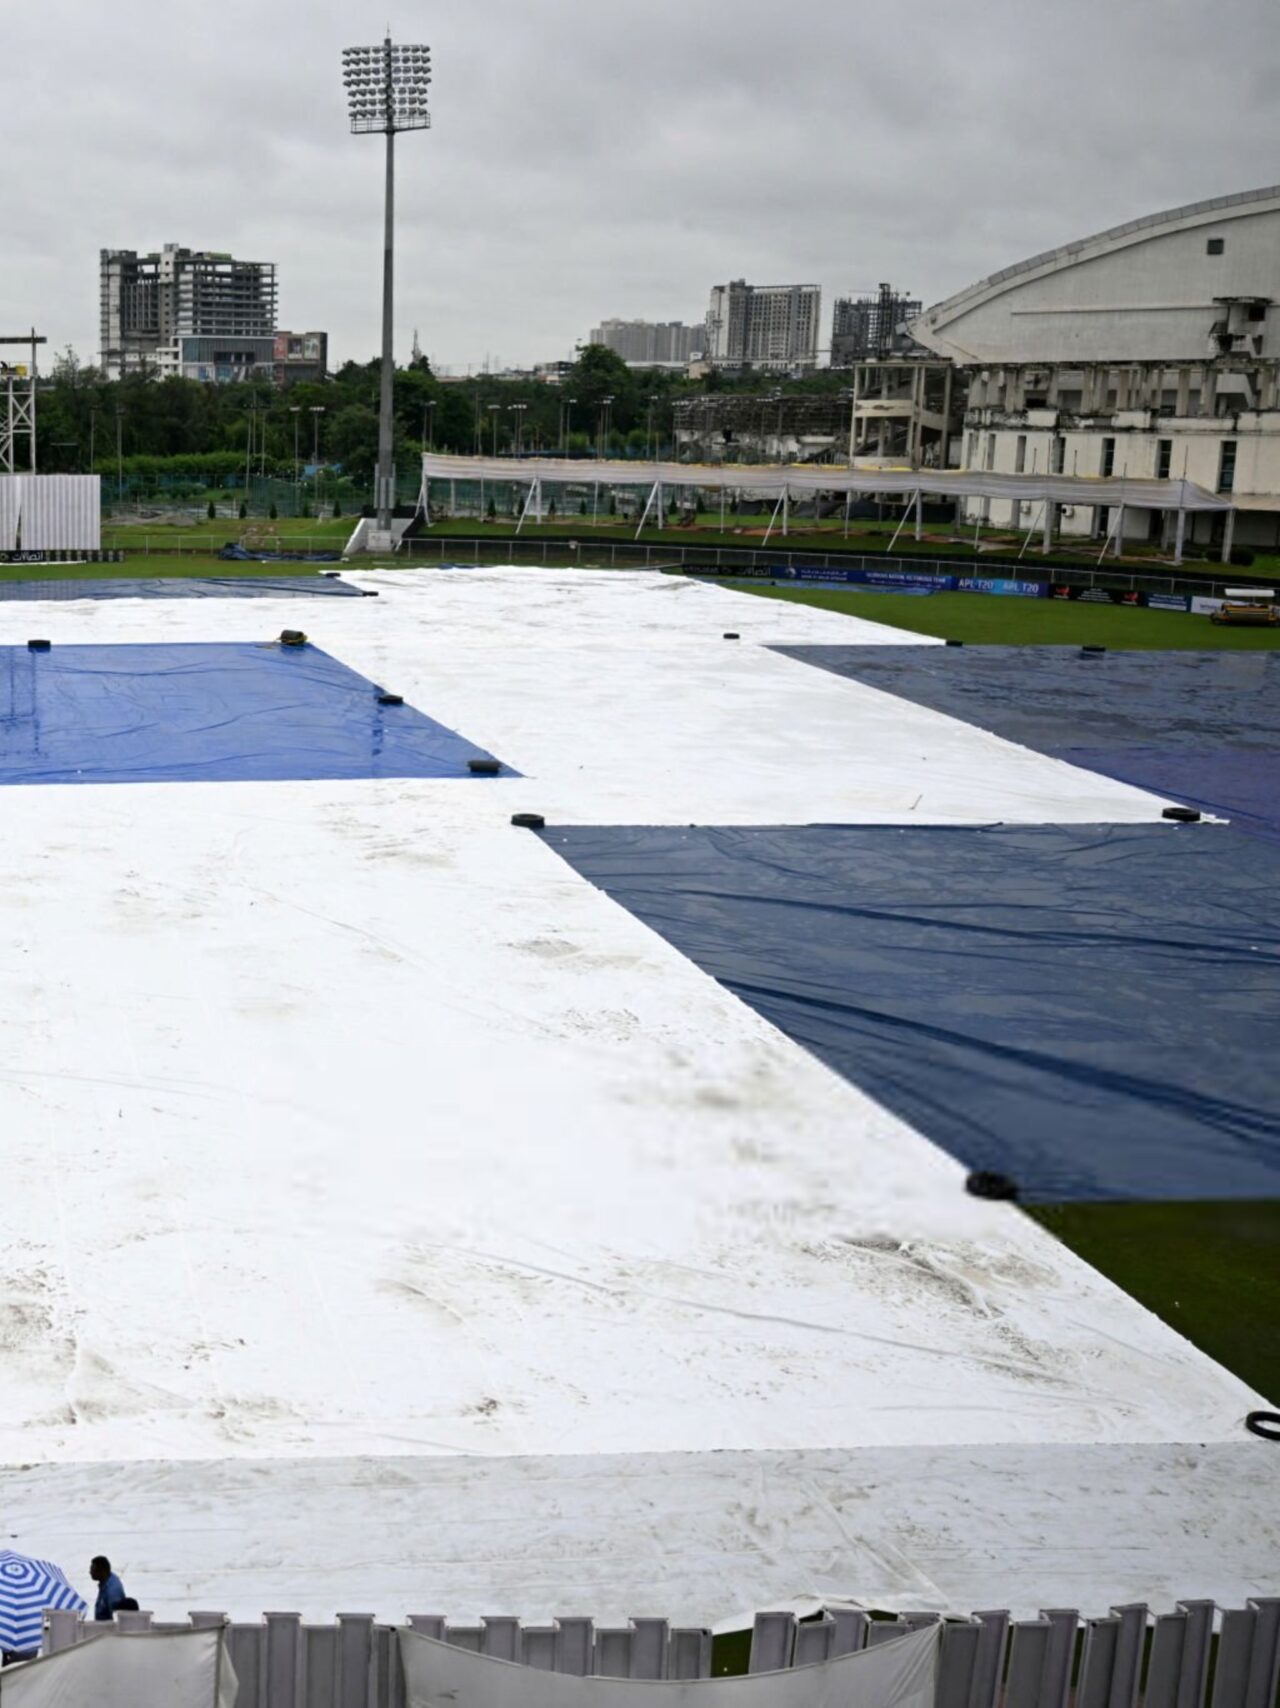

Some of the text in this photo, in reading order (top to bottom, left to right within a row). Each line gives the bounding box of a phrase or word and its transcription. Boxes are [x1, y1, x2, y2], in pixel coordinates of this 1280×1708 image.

[12, 551, 43, 561] اتصالات
[958, 579, 993, 590] APL T20
[1002, 581, 1038, 593] APL T20
